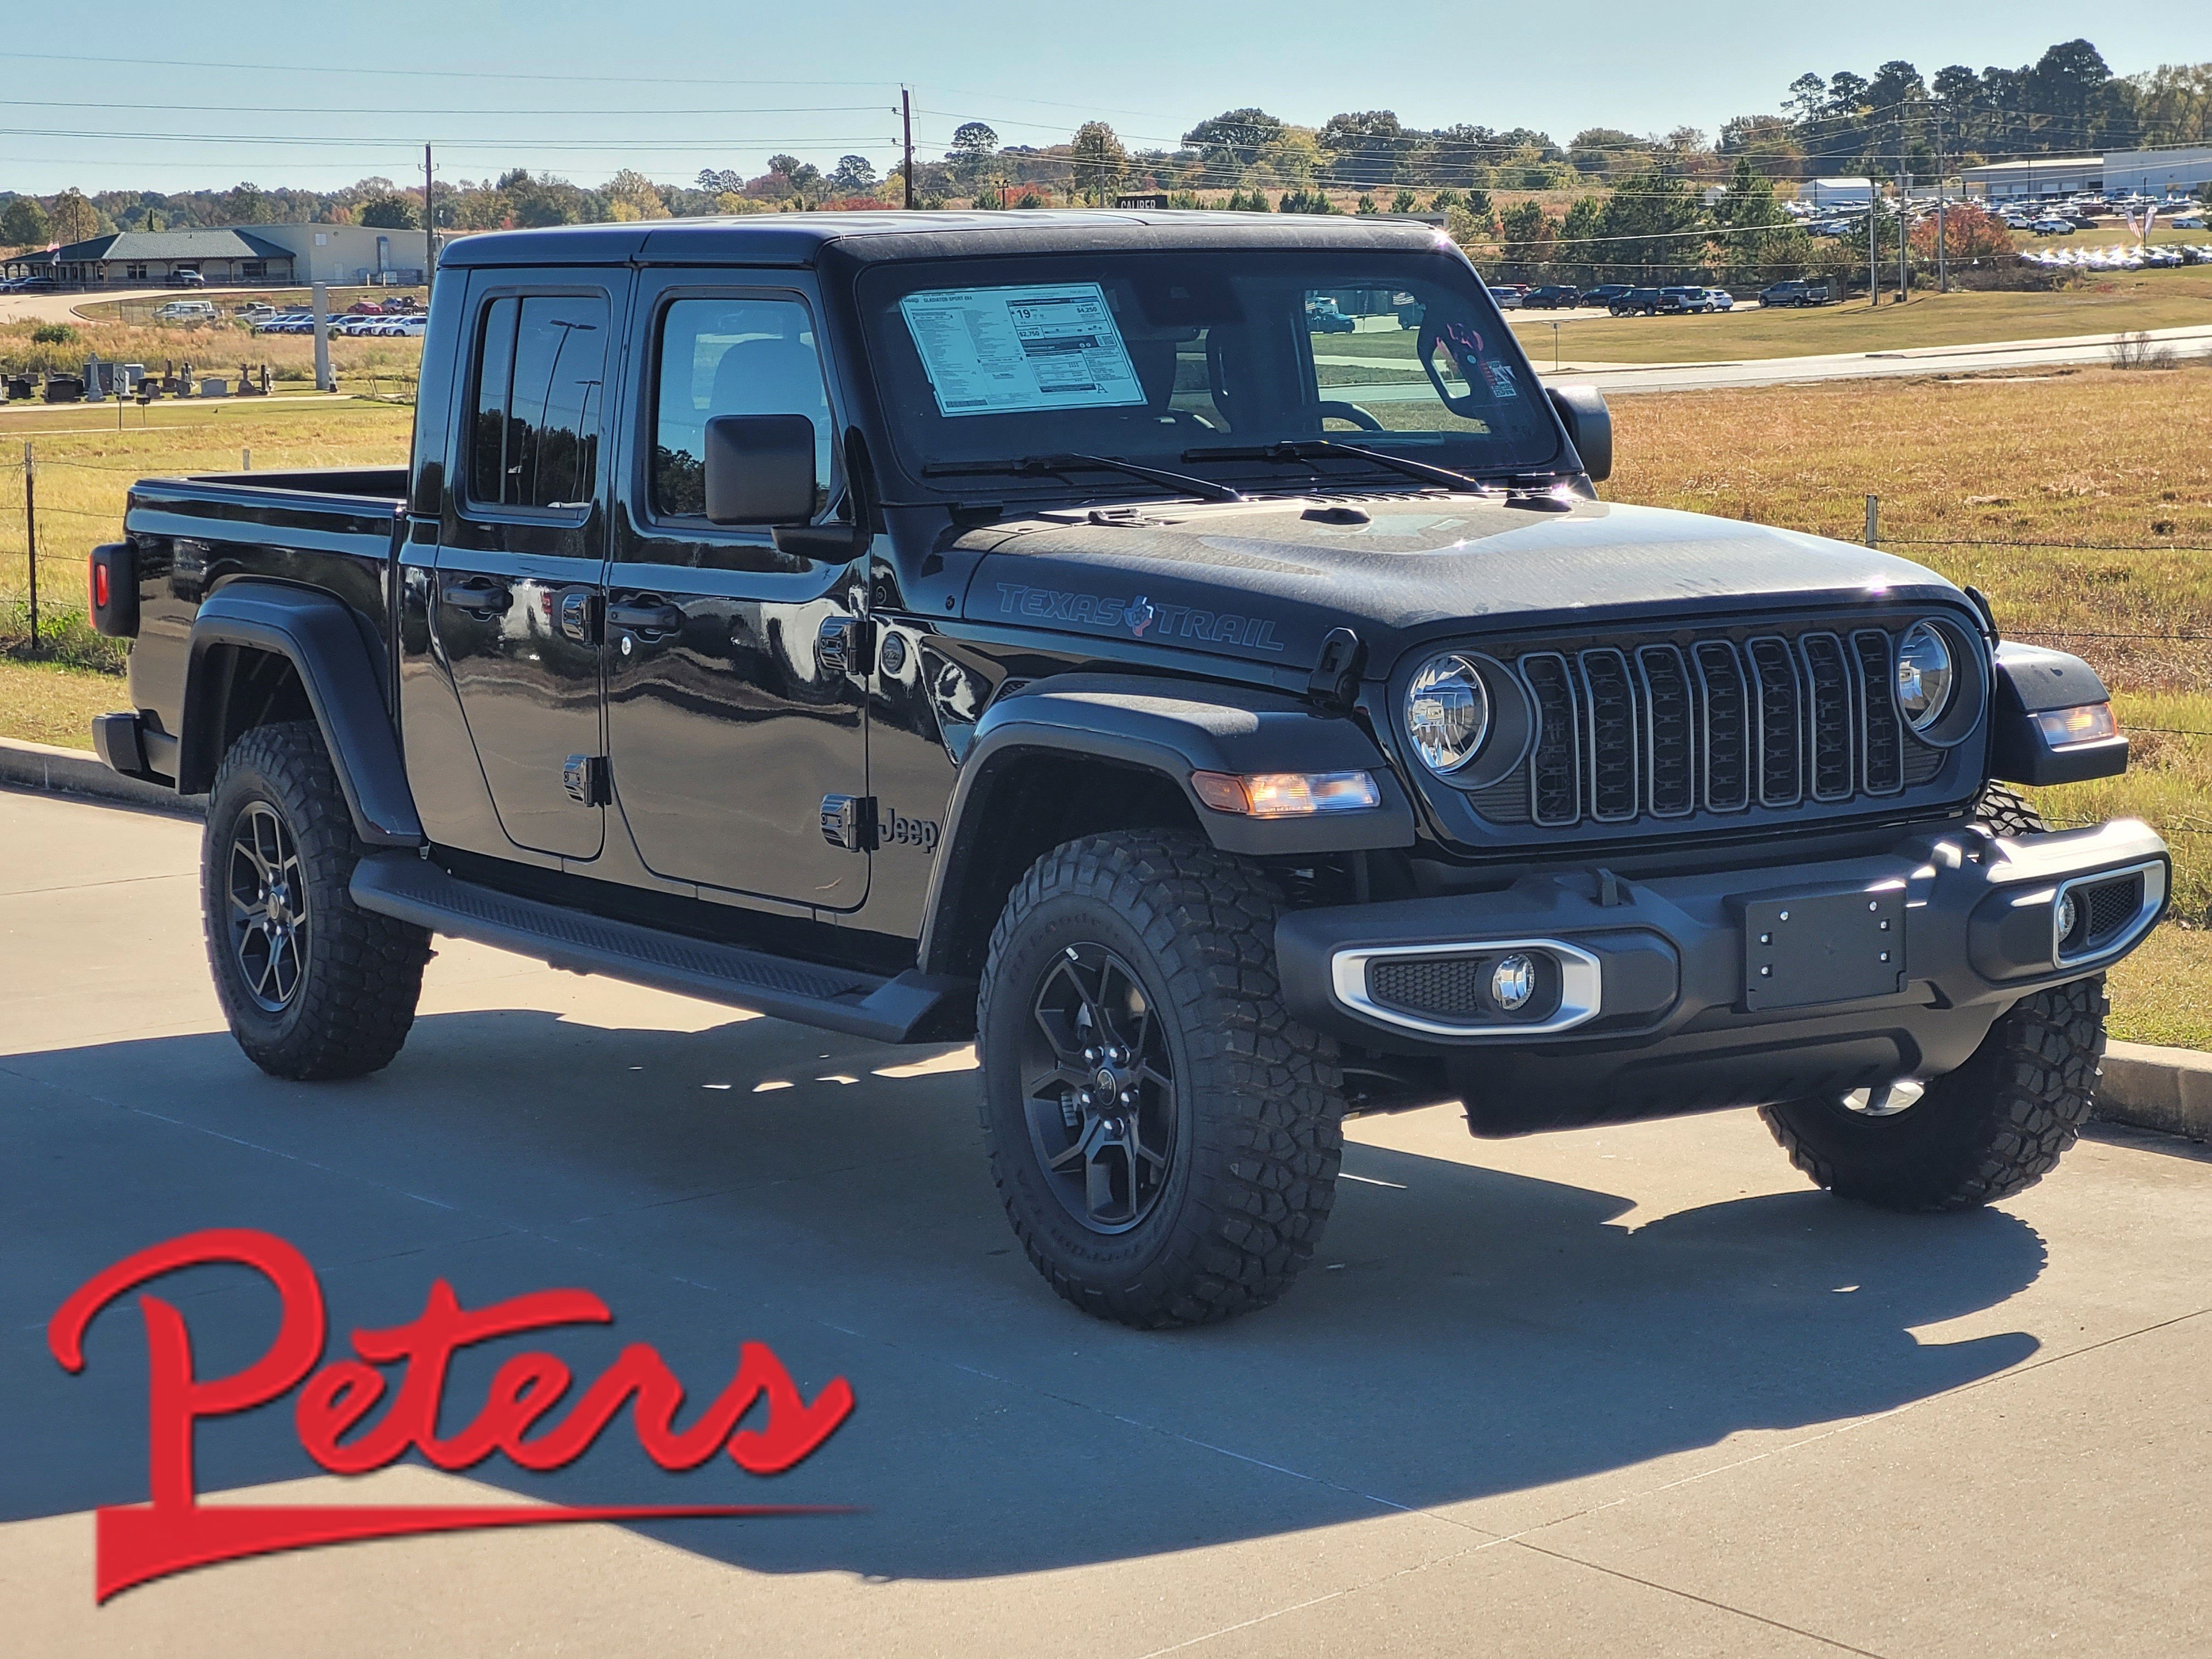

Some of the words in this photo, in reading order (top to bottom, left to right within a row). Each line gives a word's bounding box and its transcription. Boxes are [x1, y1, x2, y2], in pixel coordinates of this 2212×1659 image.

[1017, 309, 1031, 319] 19
[996, 582, 1126, 627] TEXAS
[1154, 603, 1284, 652] TRAIL
[878, 808, 939, 854] Jeep
